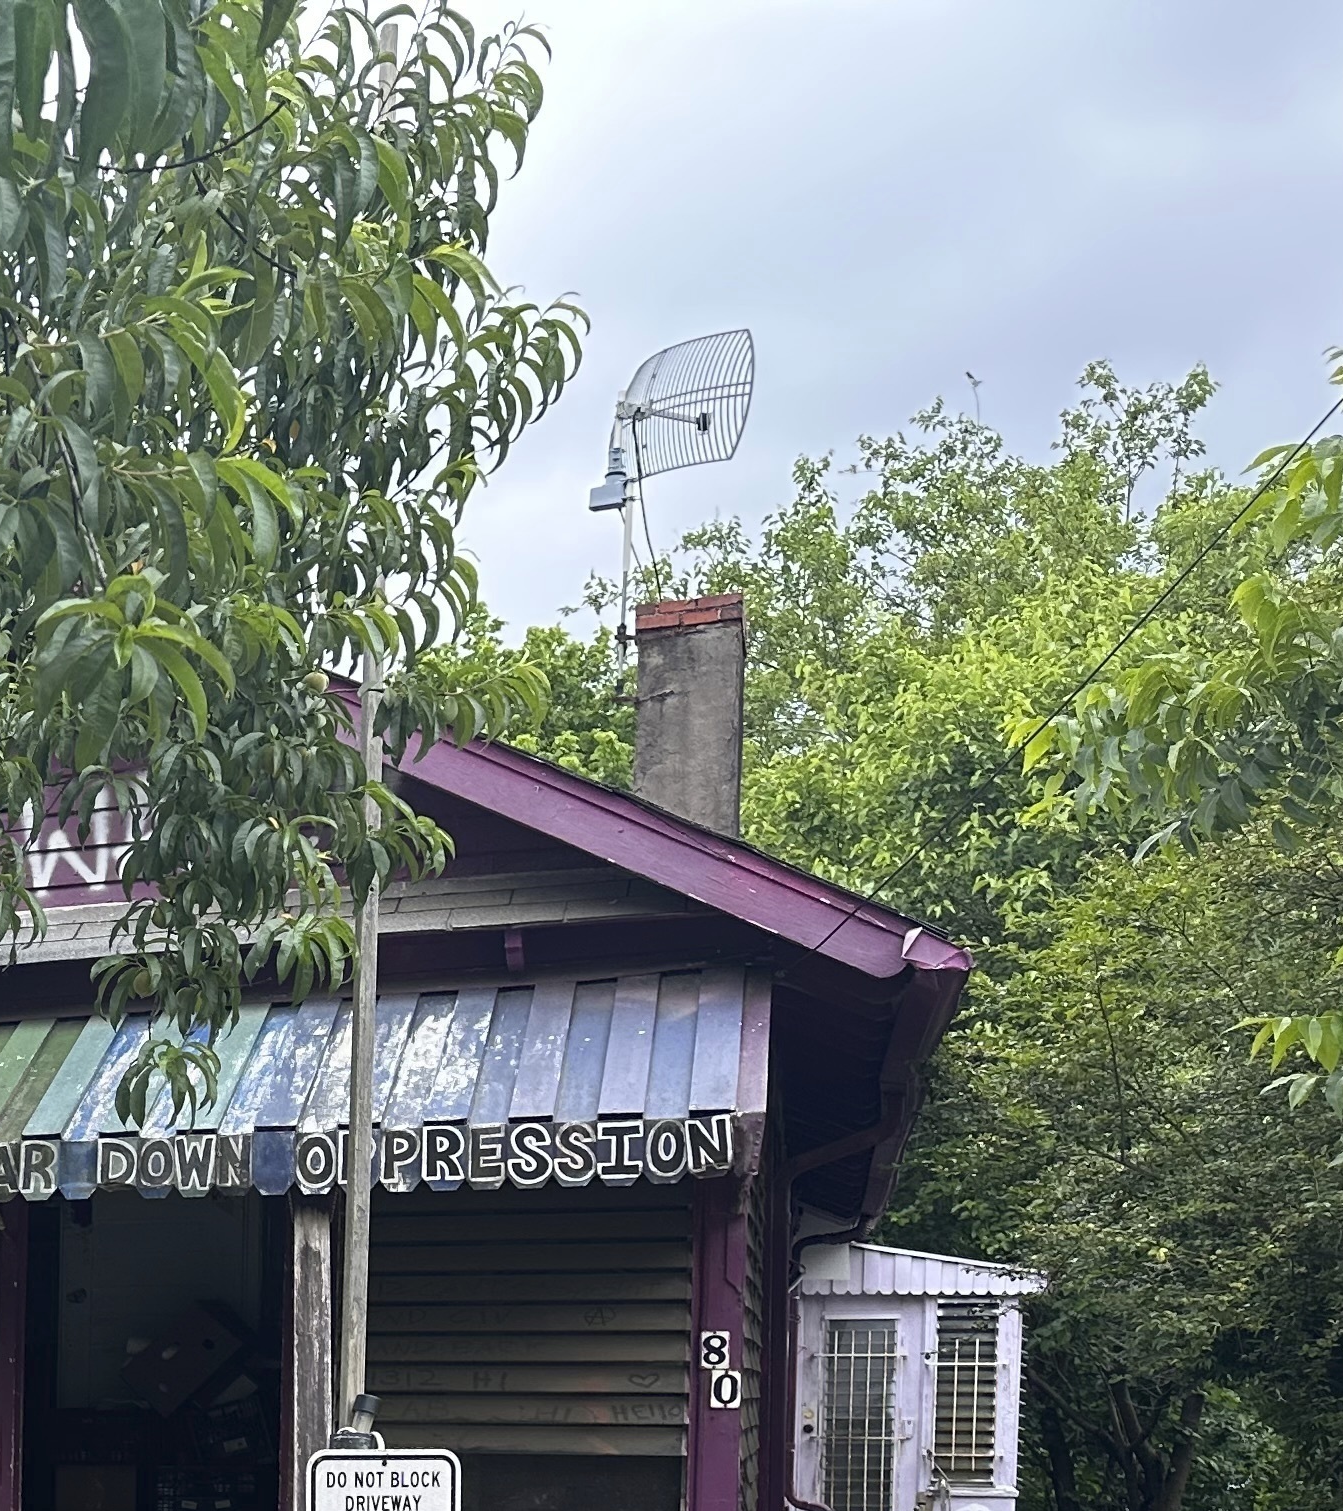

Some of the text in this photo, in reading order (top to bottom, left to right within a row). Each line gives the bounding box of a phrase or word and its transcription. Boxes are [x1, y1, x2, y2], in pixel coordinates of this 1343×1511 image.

[97, 1132, 253, 1190] DOWN
[326, 1470, 442, 1489] DO NOT BLOCK
